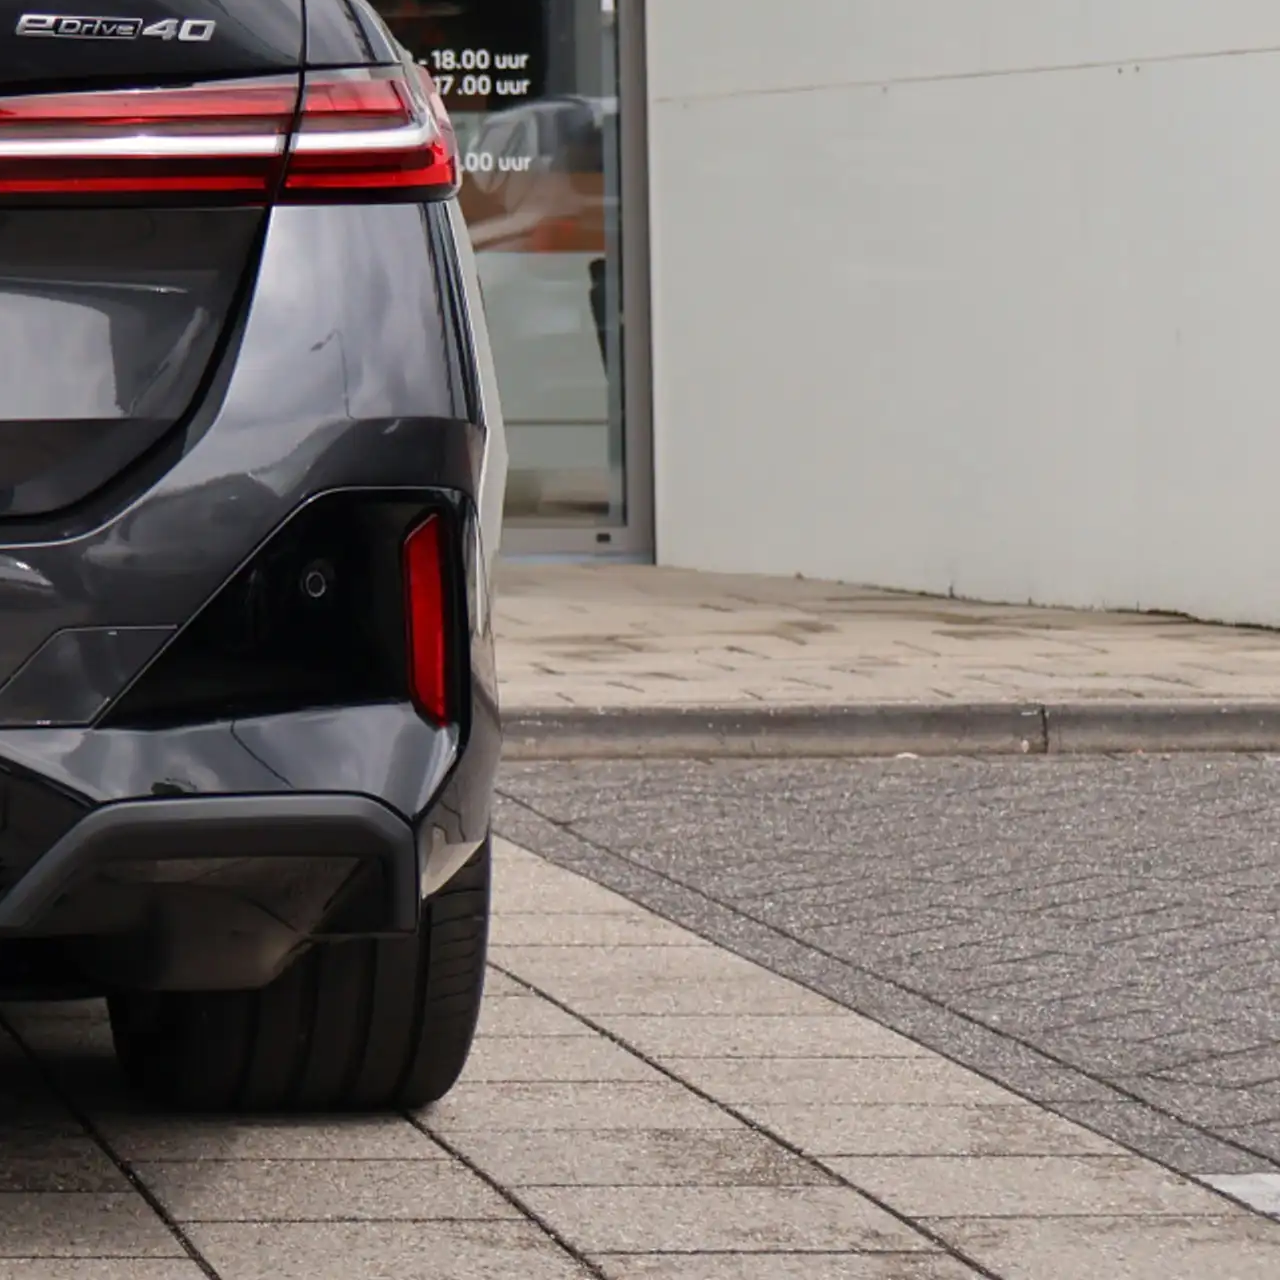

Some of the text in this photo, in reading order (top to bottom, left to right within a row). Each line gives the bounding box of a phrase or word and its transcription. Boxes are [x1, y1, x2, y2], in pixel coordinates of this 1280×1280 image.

[431, 49, 490, 70] 18.00
[494, 53, 530, 69] uur
[496, 79, 531, 95] uur
[498, 156, 533, 171] uur
